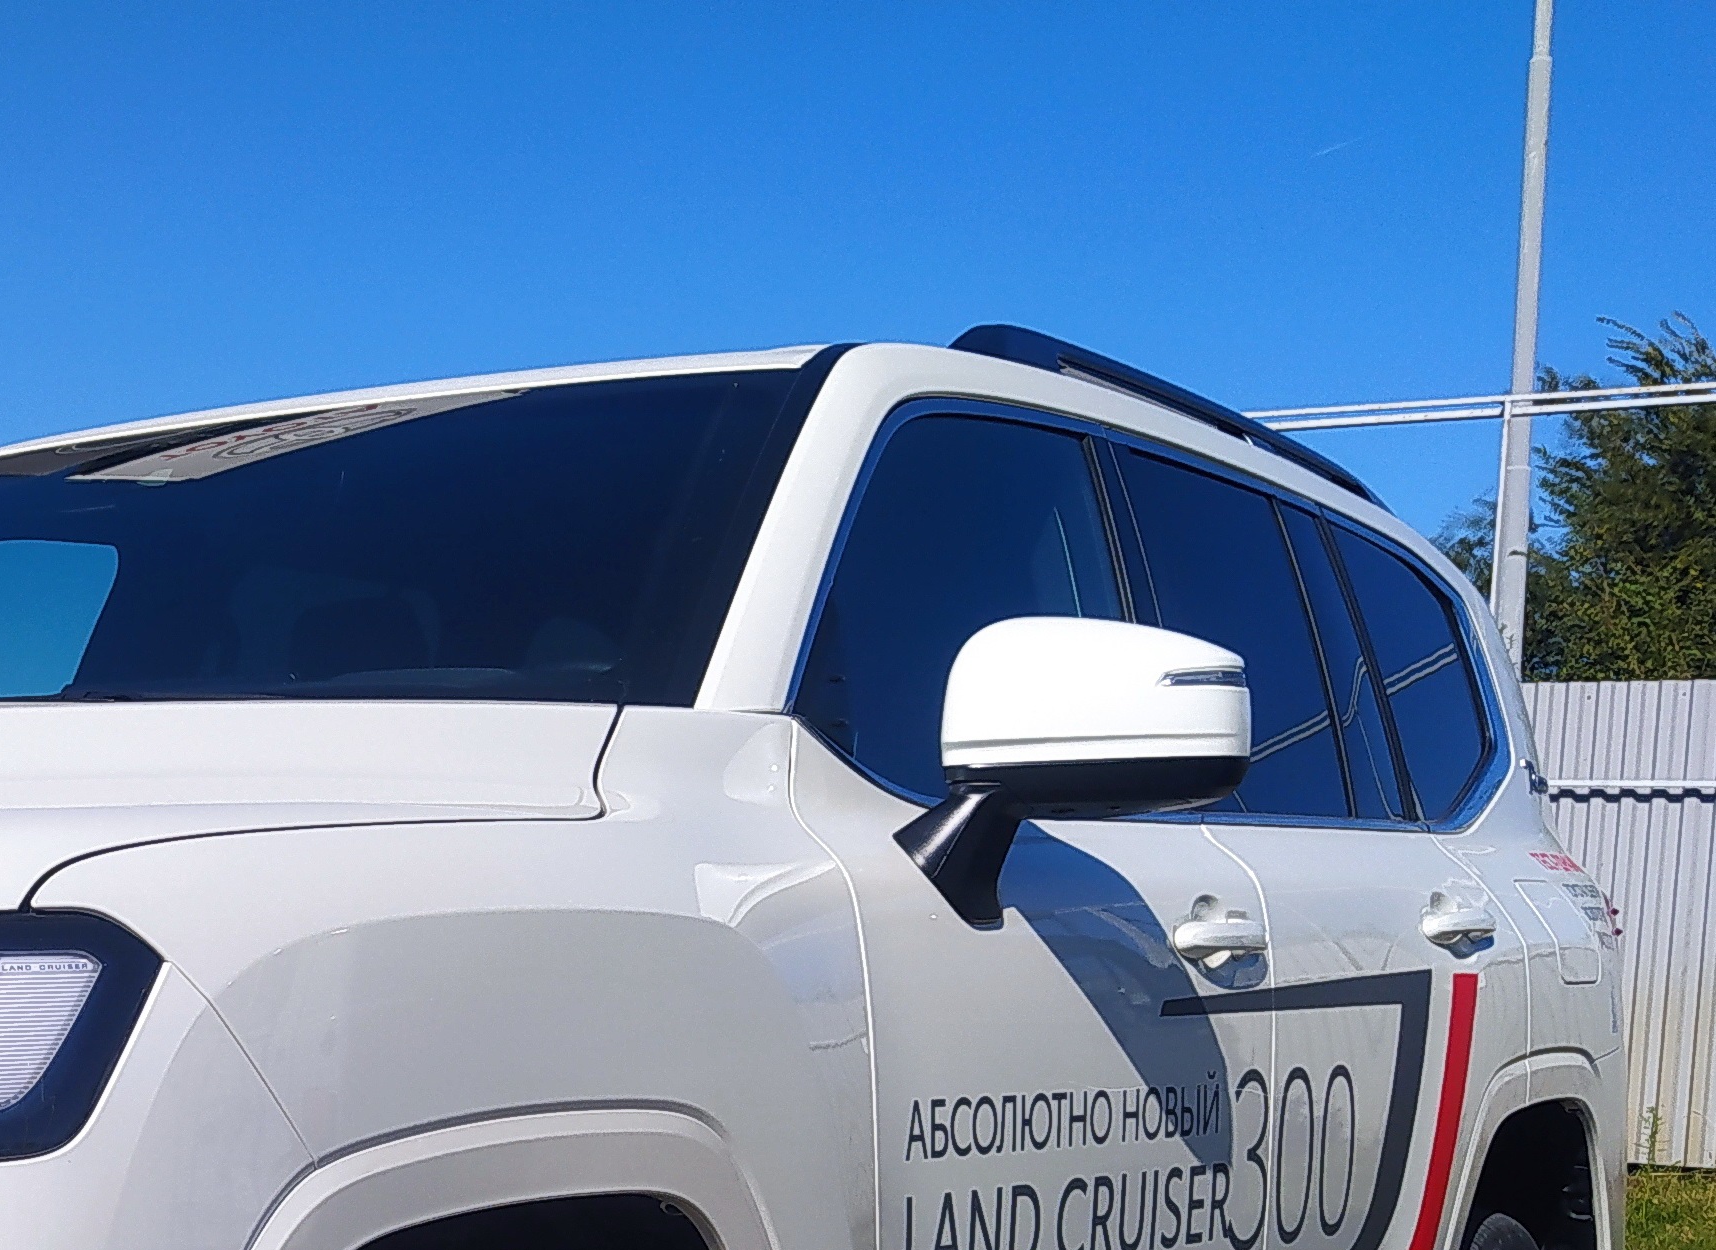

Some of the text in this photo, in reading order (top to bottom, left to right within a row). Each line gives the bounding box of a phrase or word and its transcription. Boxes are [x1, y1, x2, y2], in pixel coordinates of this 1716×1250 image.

[1, 963, 88, 972] LAND CRUISER
[905, 1070, 1220, 1161] АБСОЛЮТНО НОВЫЙ
